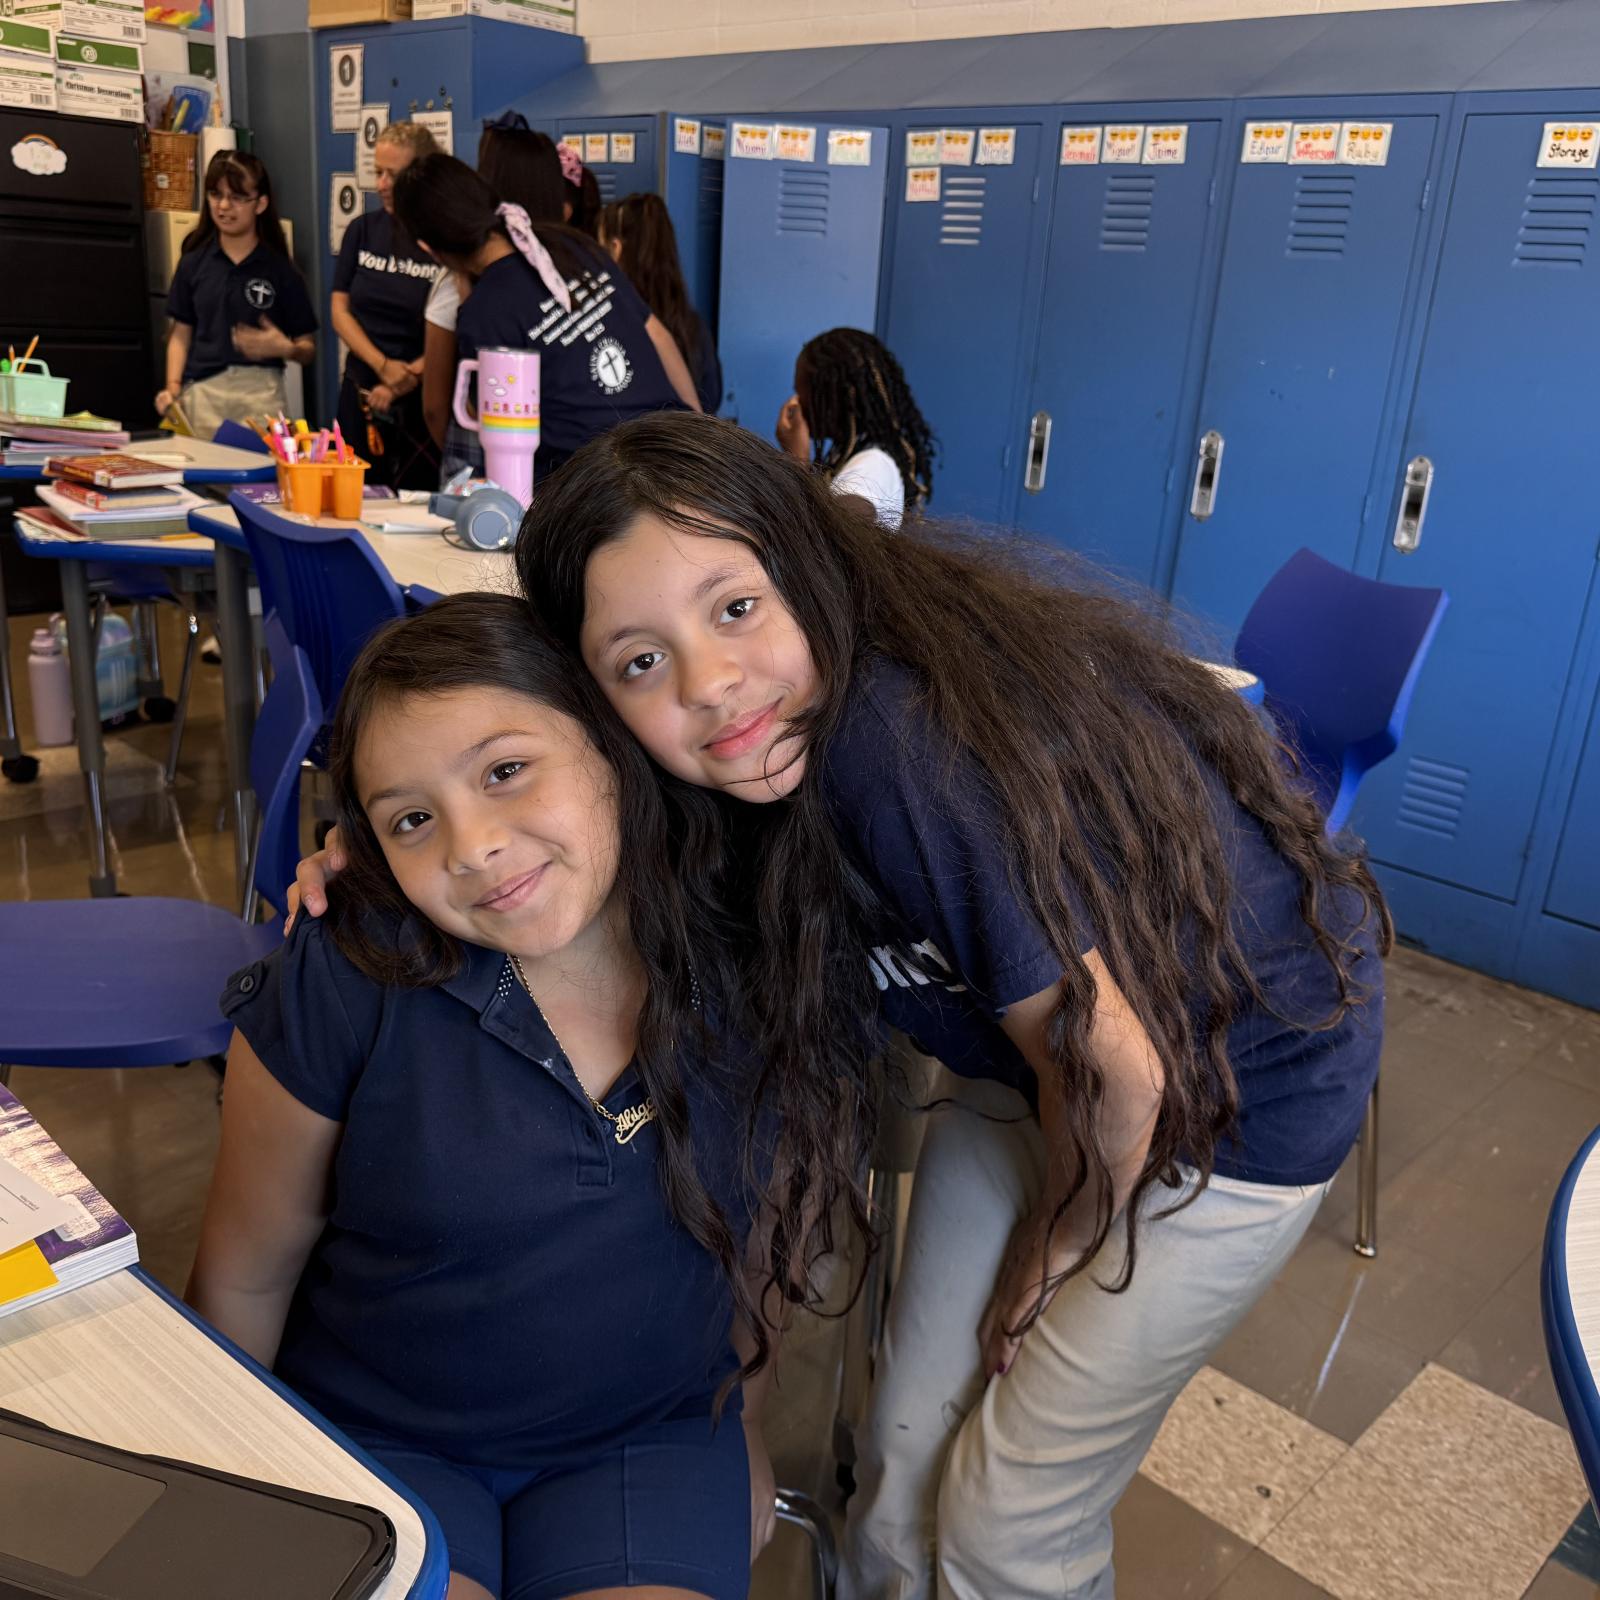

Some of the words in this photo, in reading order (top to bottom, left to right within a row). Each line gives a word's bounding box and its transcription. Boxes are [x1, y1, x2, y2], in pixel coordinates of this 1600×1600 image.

[343, 59, 351, 82] 1
[366, 121, 376, 143] 2
[1548, 142, 1590, 163] Storage
[342, 189, 352, 209] 3
[358, 249, 388, 272] You
